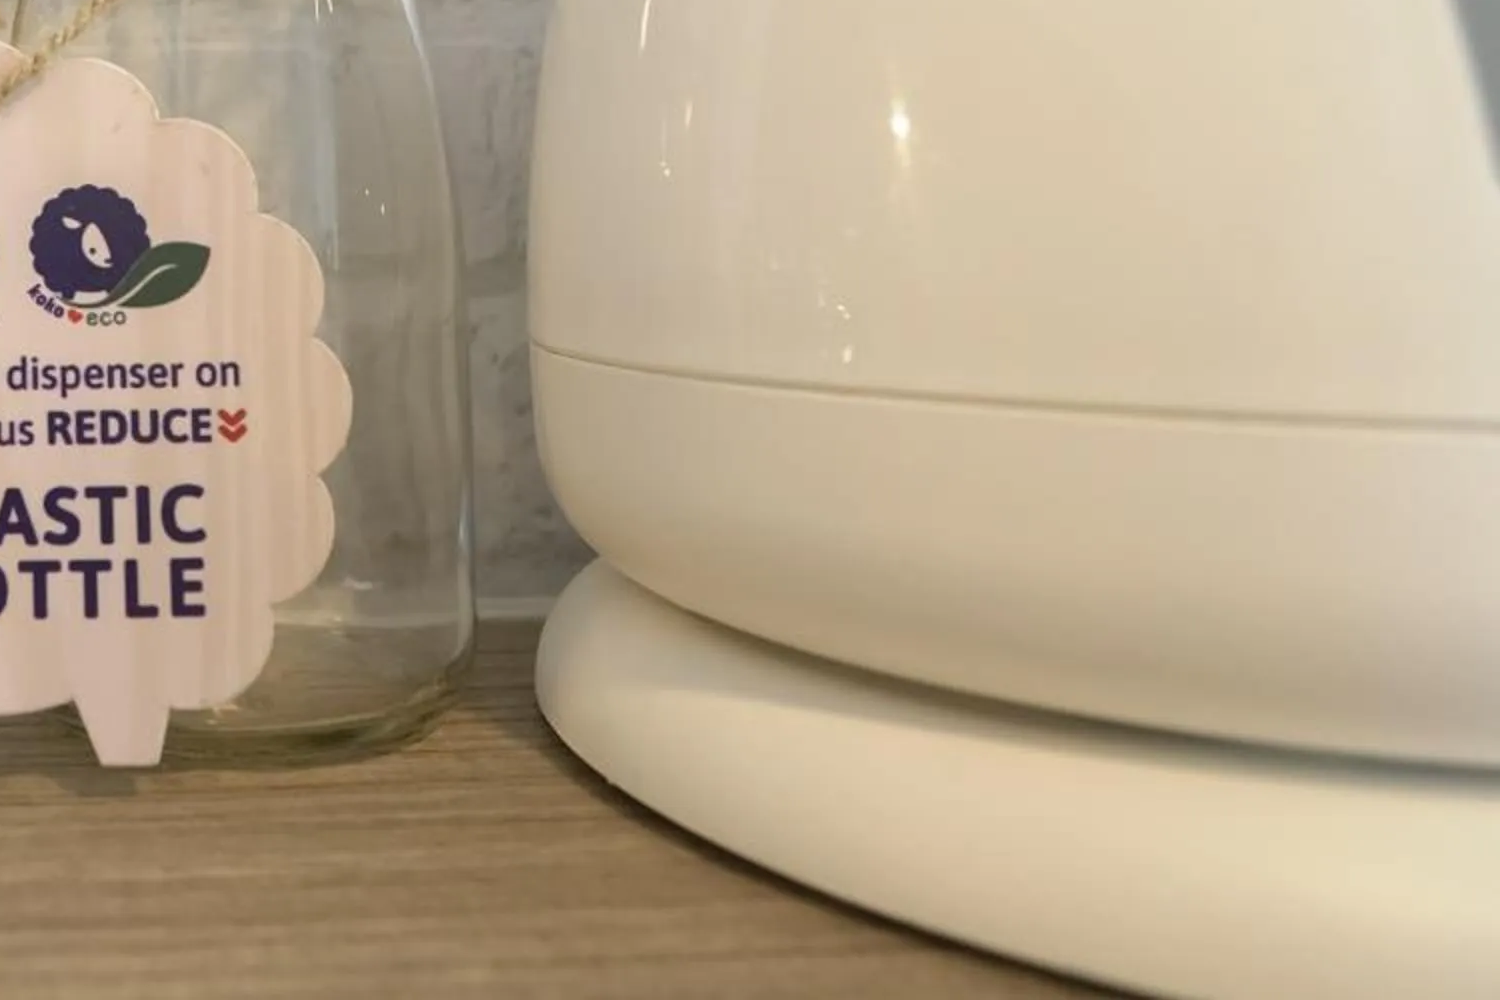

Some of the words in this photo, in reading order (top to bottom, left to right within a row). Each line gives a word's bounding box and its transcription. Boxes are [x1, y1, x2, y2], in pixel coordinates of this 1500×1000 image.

[26, 283, 65, 319] koko
[86, 311, 127, 327] eco
[5, 355, 185, 400] dispenser
[195, 361, 241, 389] on
[46, 407, 214, 447] REDUCE
